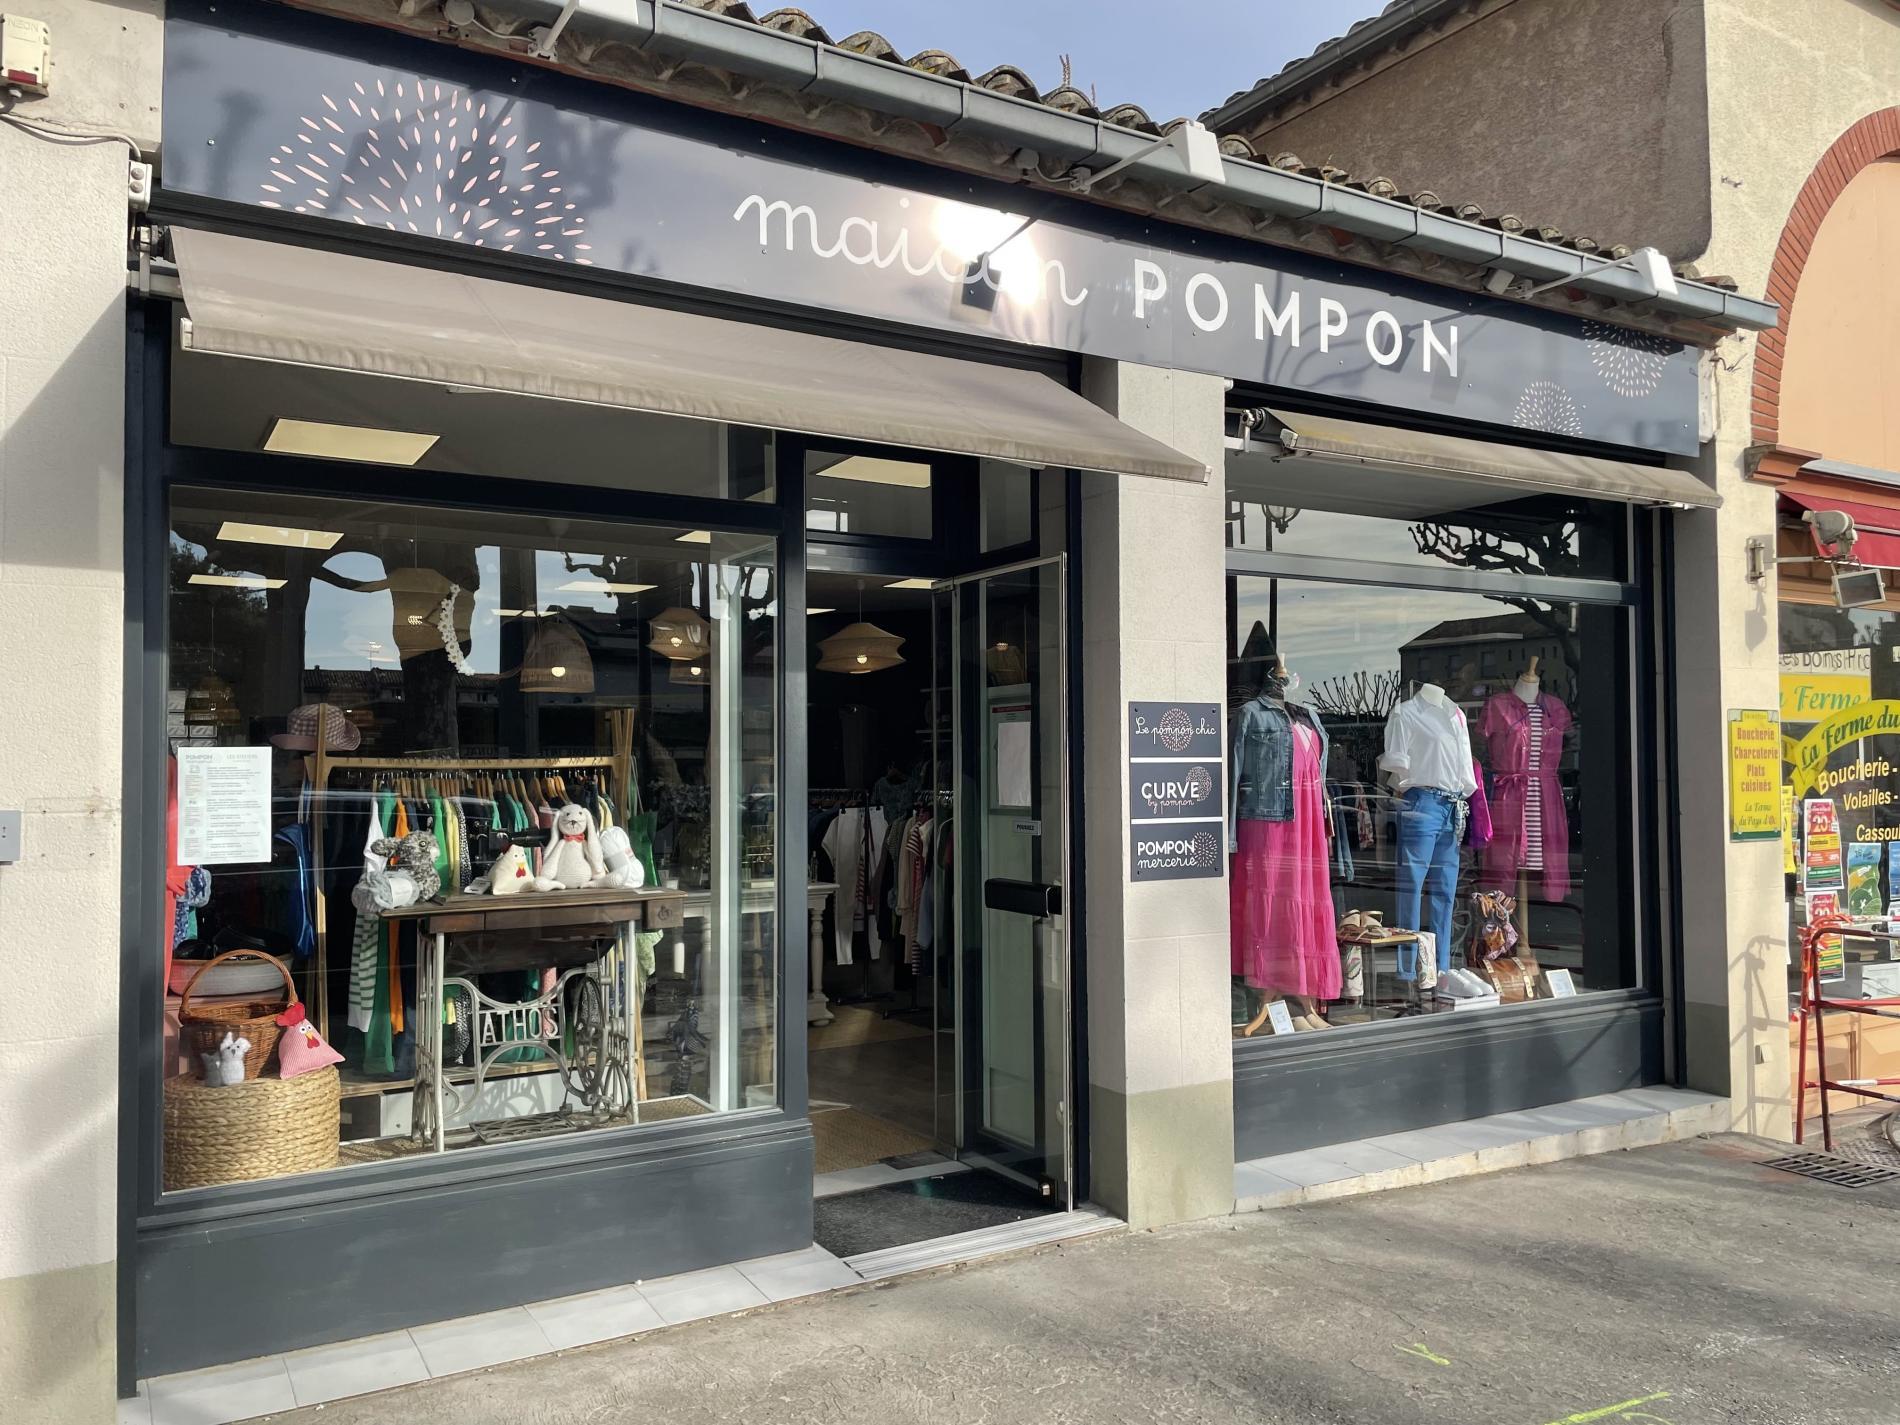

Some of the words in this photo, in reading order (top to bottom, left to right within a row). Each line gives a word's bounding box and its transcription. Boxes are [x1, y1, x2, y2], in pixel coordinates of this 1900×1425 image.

[1133, 258, 1459, 378] POMPON
[1135, 716, 1150, 735] Le
[1151, 726, 1194, 745] pompon
[1195, 717, 1217, 735] chic
[1737, 727, 1775, 741] Boucherie
[1801, 743, 1819, 769] La
[1821, 713, 1873, 753] Ferme
[1876, 705, 1900, 729] du
[1734, 745, 1779, 760] Charcuterie
[1746, 764, 1766, 777] Plats
[1818, 756, 1890, 796] Boucherie
[1141, 782, 1200, 800] CURVE
[1843, 788, 1892, 812] Volailles
[1147, 799, 1158, 815] by
[1160, 799, 1195, 815] pompon
[1137, 839, 1196, 856] POMPON
[1136, 856, 1198, 870] mercerie
[481, 1007, 559, 1046] ATHOS
